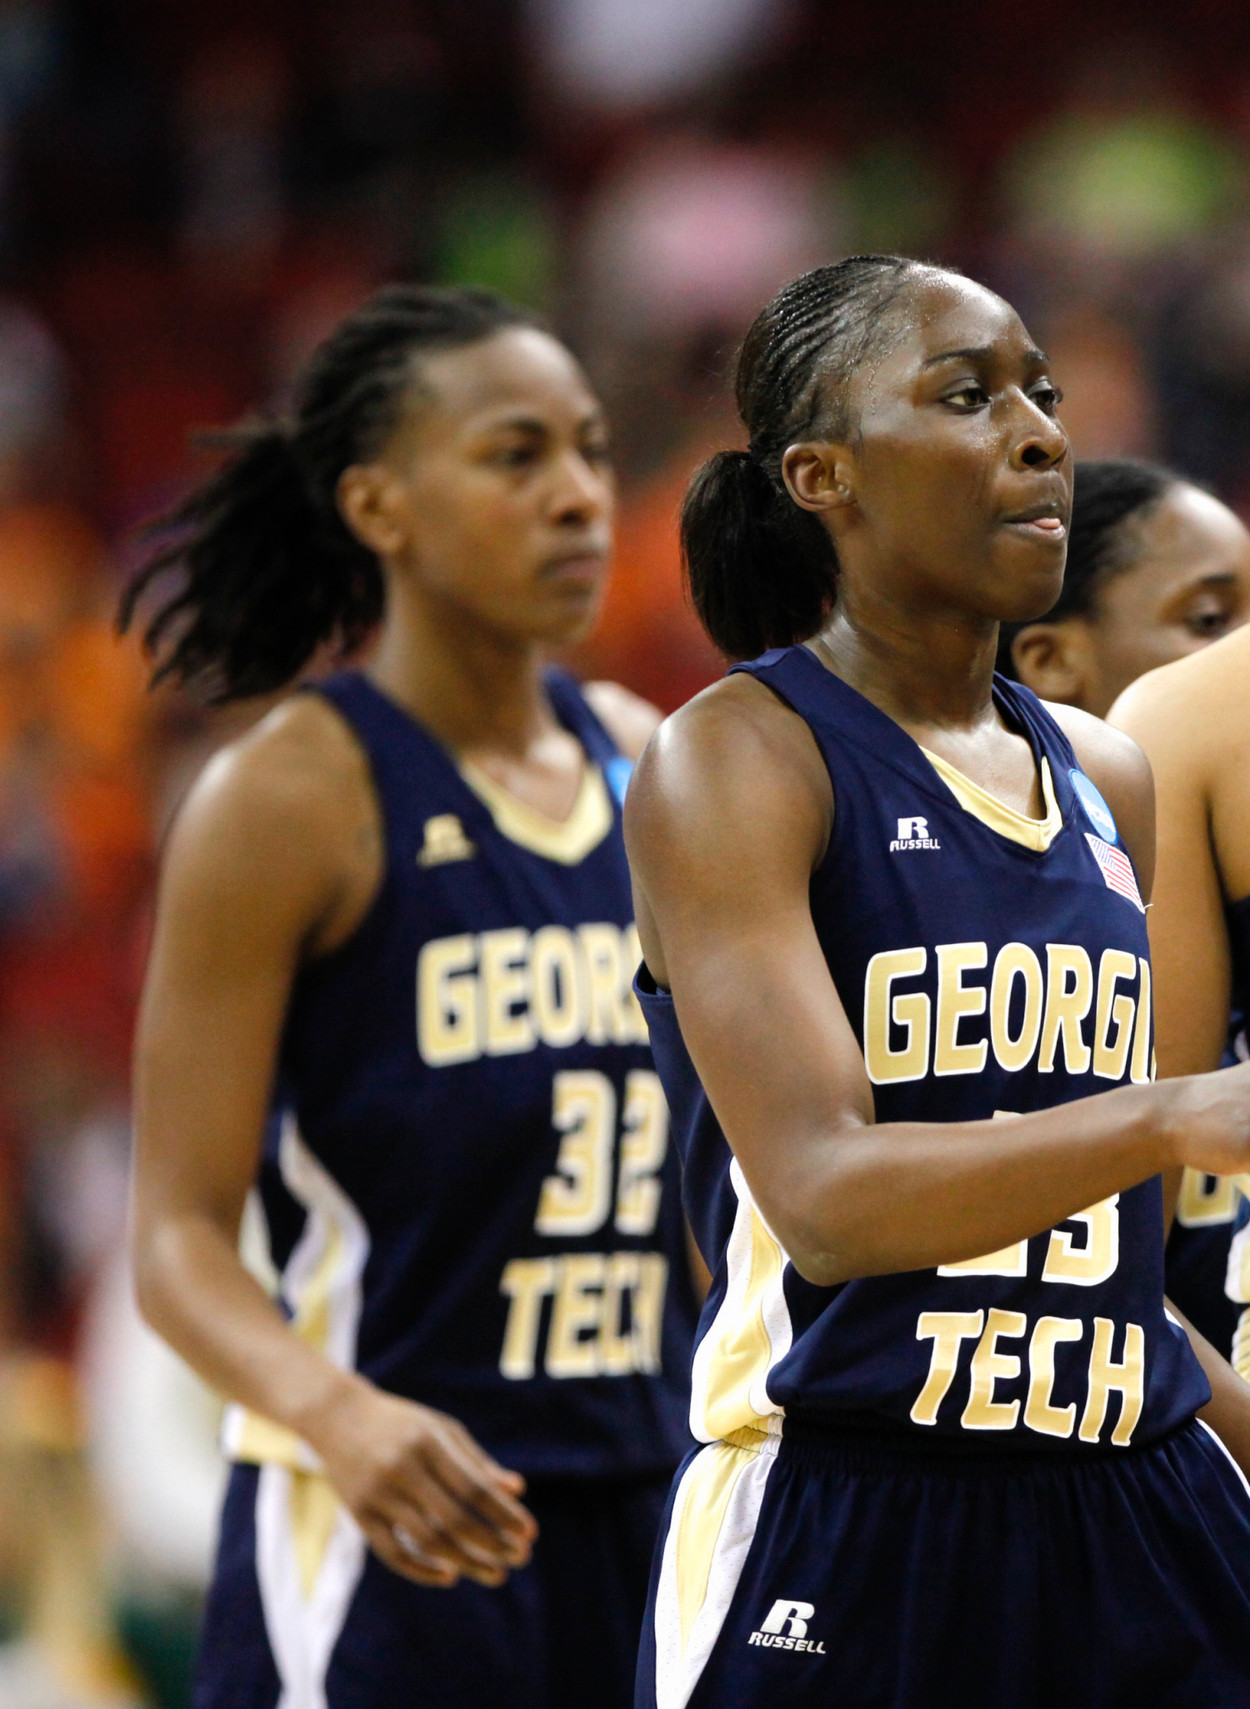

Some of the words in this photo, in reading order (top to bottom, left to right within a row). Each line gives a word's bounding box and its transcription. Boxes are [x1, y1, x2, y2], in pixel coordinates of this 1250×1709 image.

[889, 838, 942, 853] RUSSELL
[863, 942, 1157, 1085] GEORGI
[533, 1068, 671, 1237] 32
[909, 1308, 1146, 1447] TECH
[747, 1631, 827, 1655] RUSSELL
